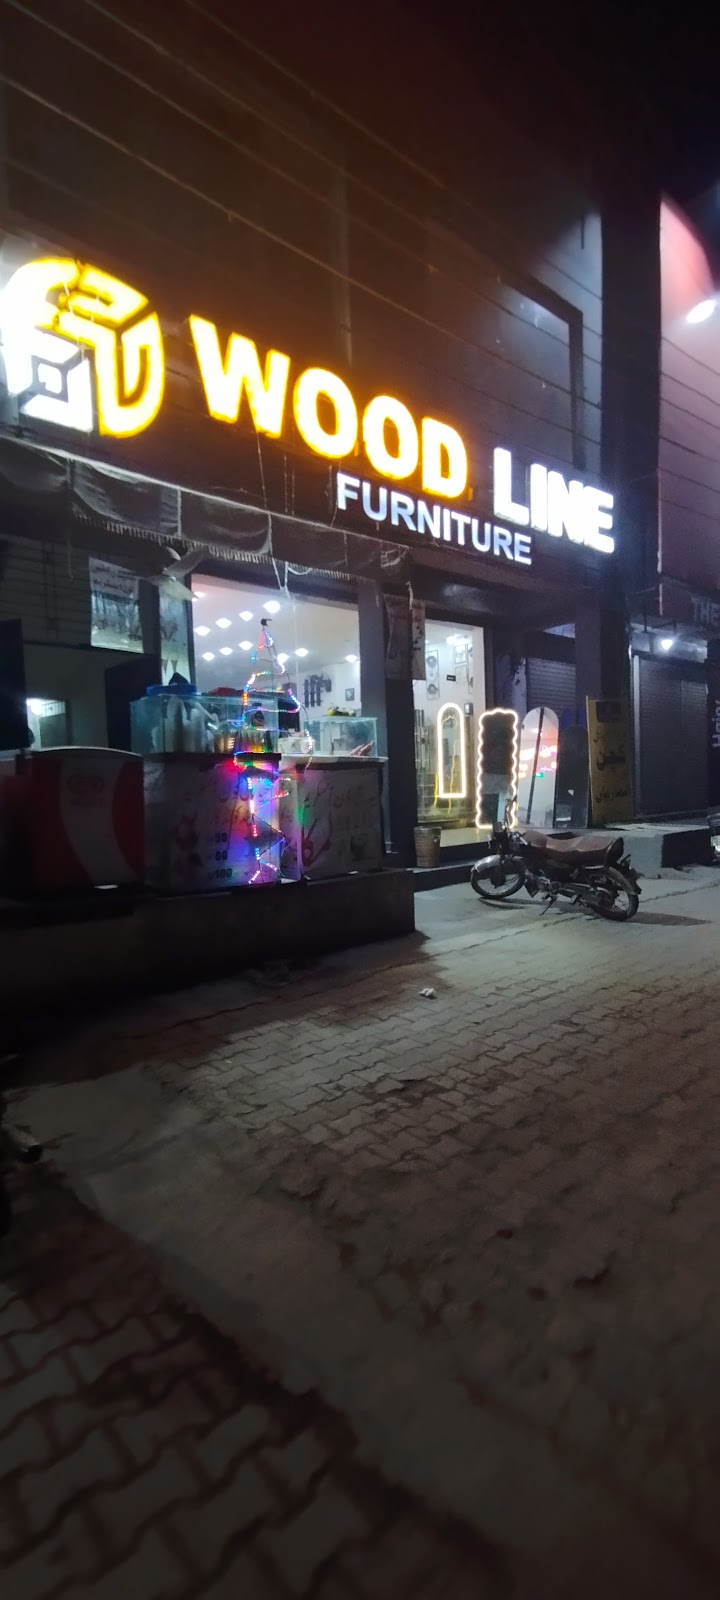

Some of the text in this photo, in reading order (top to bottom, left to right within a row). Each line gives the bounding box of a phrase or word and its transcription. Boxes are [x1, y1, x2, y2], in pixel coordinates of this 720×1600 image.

[188, 313, 615, 553] WOOD LINE
[336, 471, 532, 566] FURNITURE
